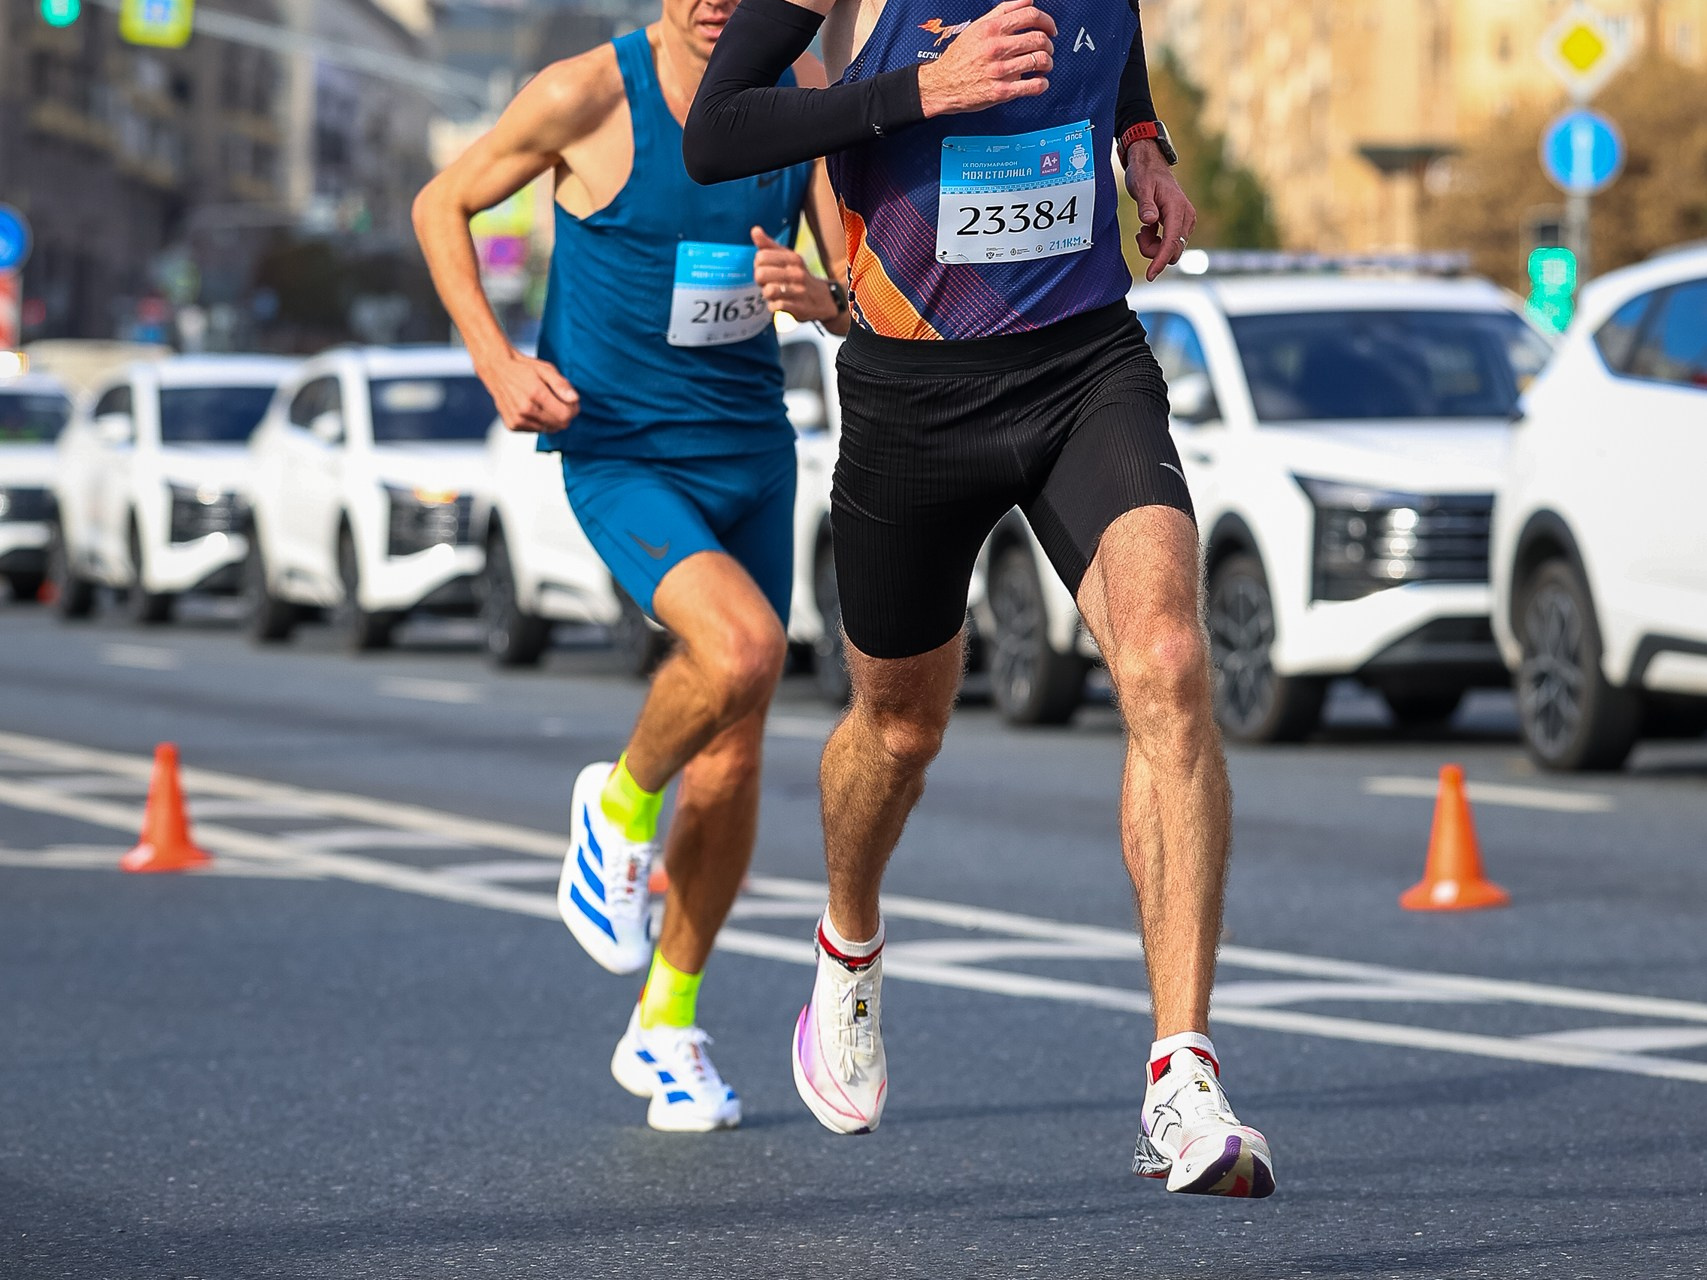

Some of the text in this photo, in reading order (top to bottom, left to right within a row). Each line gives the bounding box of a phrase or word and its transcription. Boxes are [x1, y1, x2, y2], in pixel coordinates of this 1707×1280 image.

[969, 160, 1018, 168] ПОЛУМАРАФОН
[962, 167, 1032, 180] МОЯ СТОЛИЦА
[956, 195, 1078, 236] 23384
